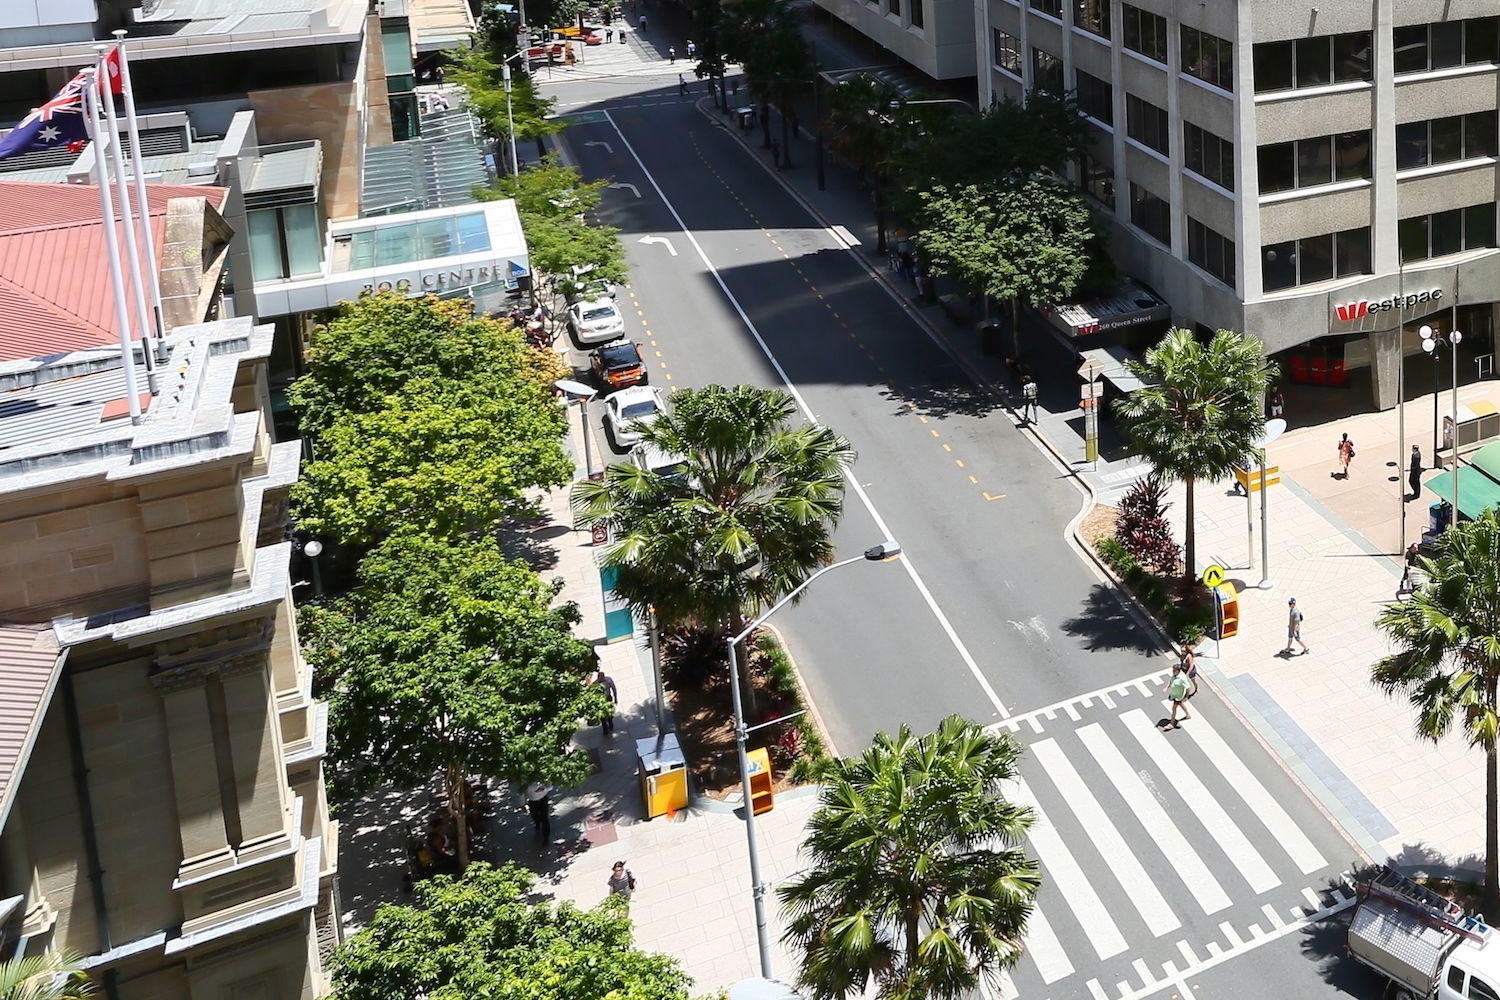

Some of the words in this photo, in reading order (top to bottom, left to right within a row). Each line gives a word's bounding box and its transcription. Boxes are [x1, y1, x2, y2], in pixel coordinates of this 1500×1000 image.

[422, 264, 501, 287] CENTRE
[1334, 288, 1443, 321] Westpac
[1111, 320, 1131, 329] Queen
[1132, 315, 1152, 324] Street
